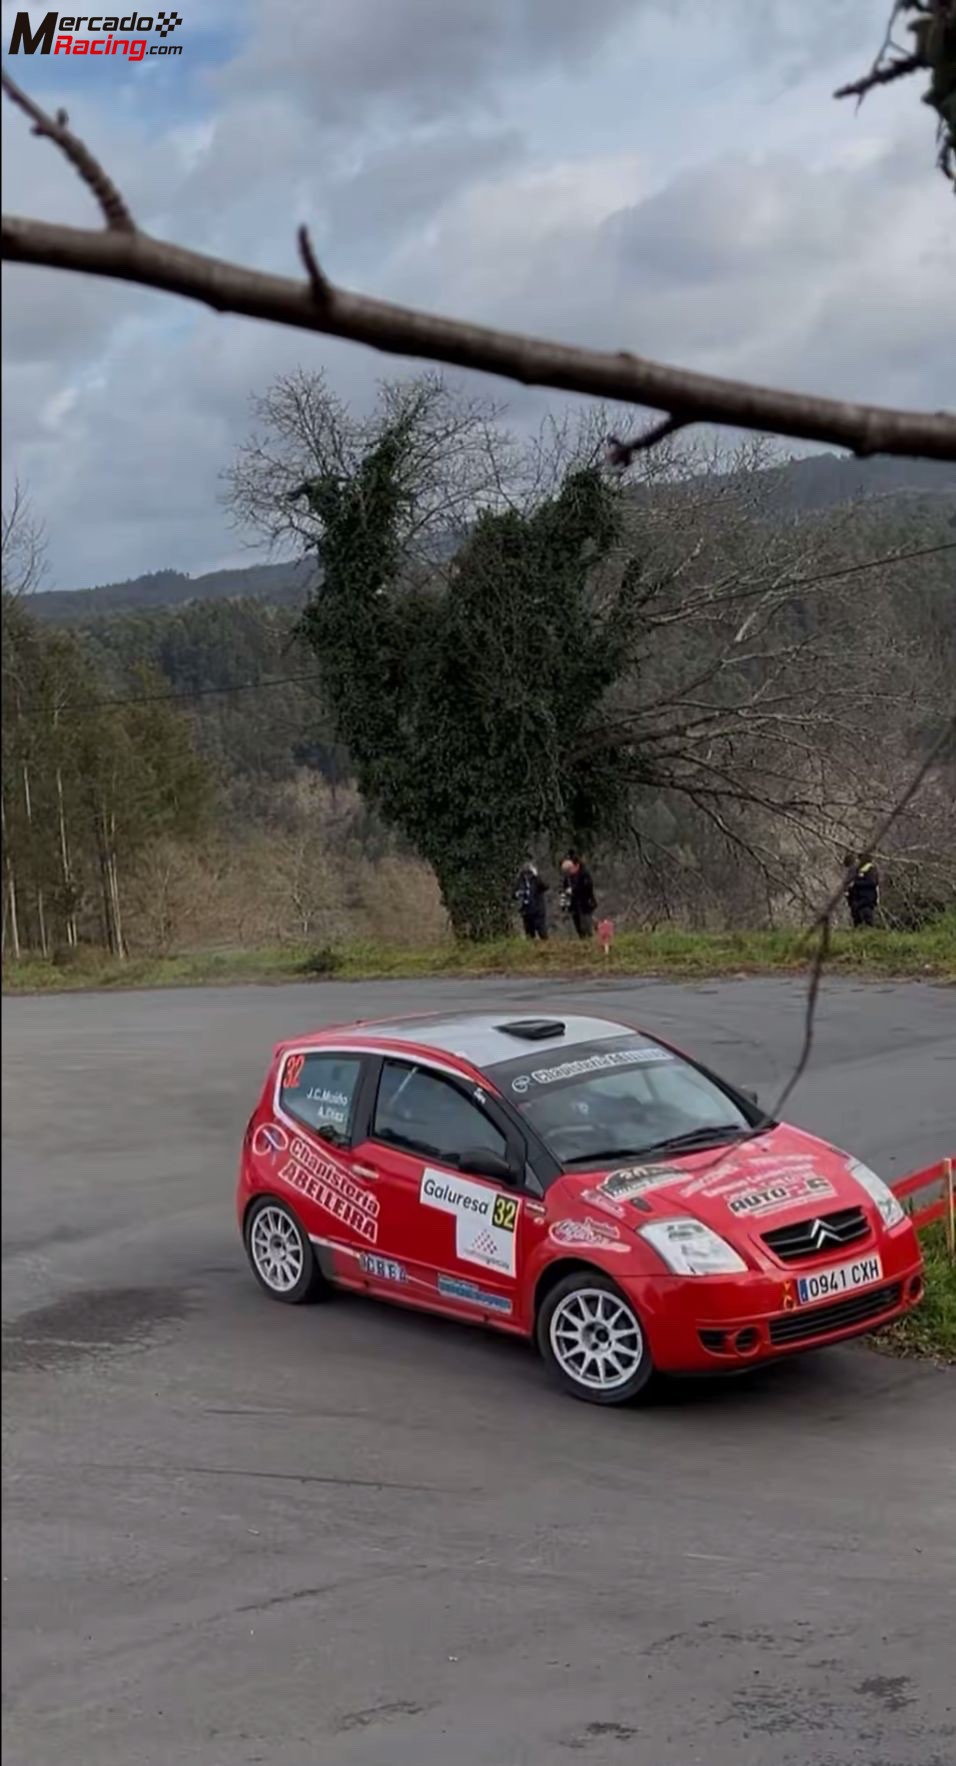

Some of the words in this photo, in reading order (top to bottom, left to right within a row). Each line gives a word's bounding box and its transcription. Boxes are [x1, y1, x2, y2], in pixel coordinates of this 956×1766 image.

[283, 1054, 305, 1088] 32
[278, 1159, 378, 1243] ABELLEIRA
[423, 1178, 489, 1215] Galuresa
[493, 1198, 516, 1229] 32
[728, 1187, 787, 1213] AUTO
[809, 1269, 847, 1298] 0941
[851, 1258, 879, 1284] CXH
